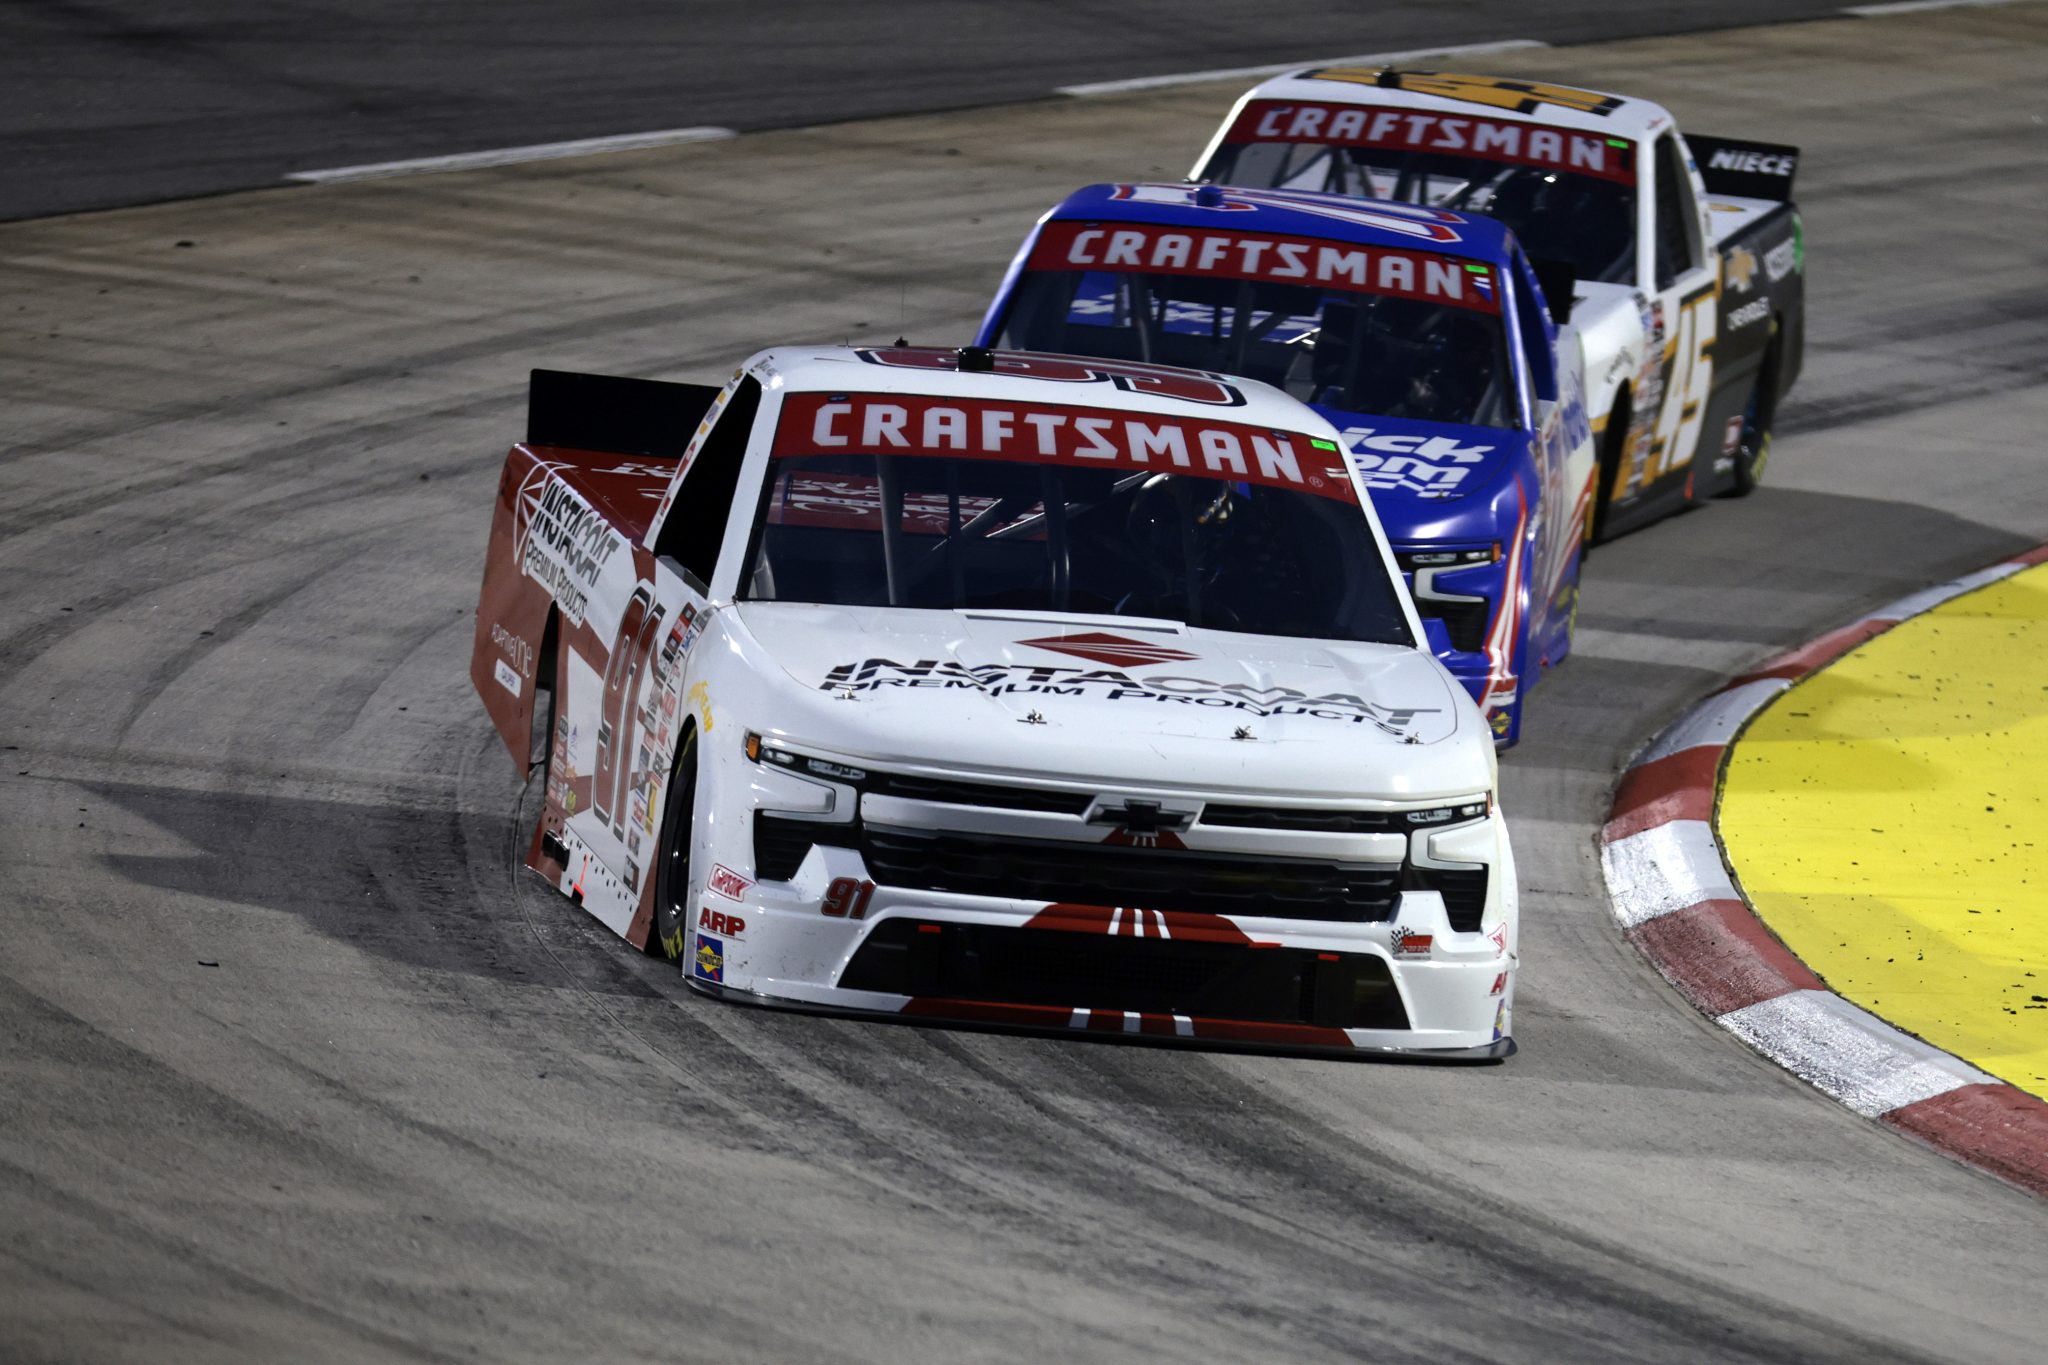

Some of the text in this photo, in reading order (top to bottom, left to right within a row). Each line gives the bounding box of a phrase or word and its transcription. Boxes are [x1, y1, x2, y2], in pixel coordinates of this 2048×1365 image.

[1255, 106, 1605, 171] CRAFTSMAN
[1708, 148, 1794, 176] NIECE
[1067, 230, 1463, 300] CRAFTSMAN
[812, 403, 1305, 485] CRAFTSMAN
[525, 538, 559, 593] PREMIUM
[555, 567, 588, 622] PRODUCTS
[819, 678, 1405, 736] PREMIUM PRODUCTS
[699, 907, 745, 937] ARP
[821, 876, 877, 921] 91
